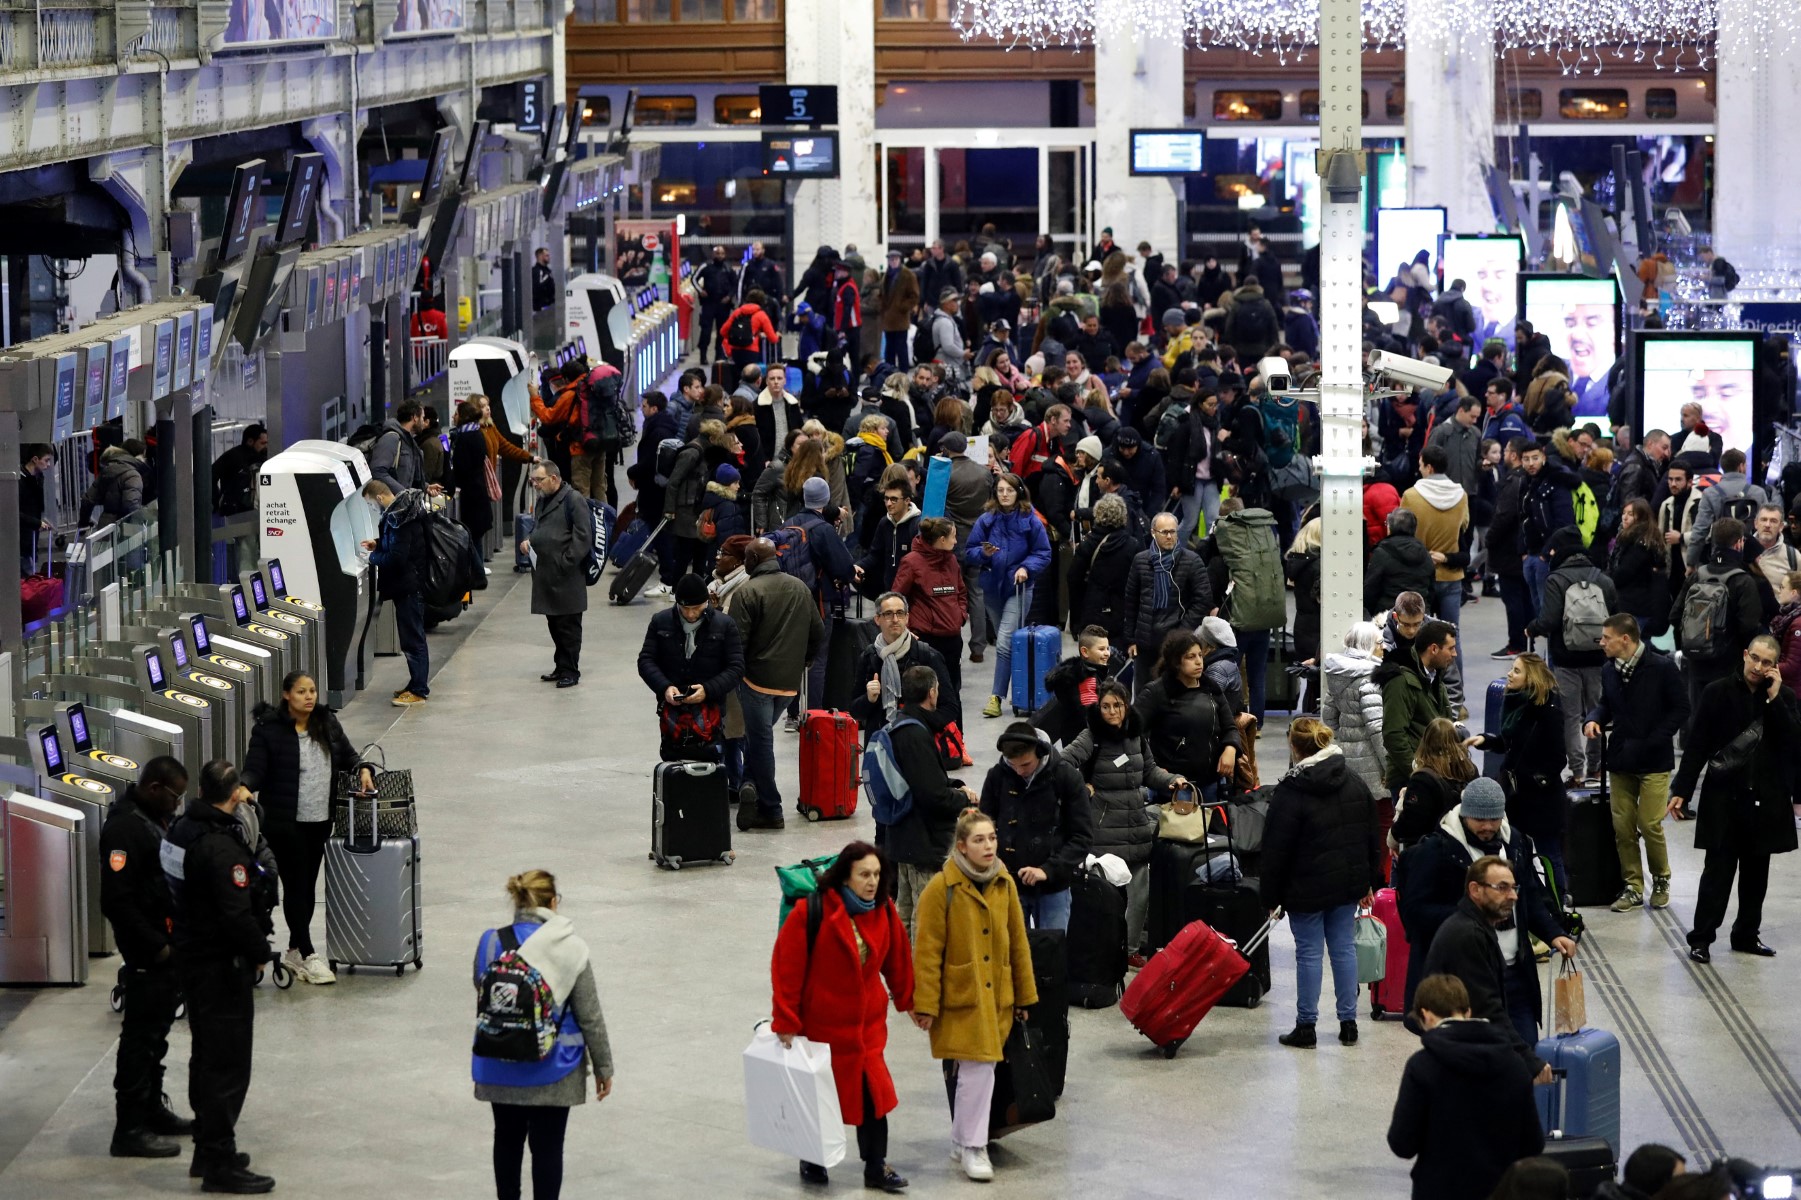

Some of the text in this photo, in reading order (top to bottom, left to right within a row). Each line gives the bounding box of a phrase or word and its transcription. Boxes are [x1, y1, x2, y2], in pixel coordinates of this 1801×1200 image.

[524, 95, 535, 123] 5
[792, 98, 806, 117] 5
[240, 195, 252, 234] 19
[296, 184, 310, 219] 17
[266, 517, 297, 525] échange
